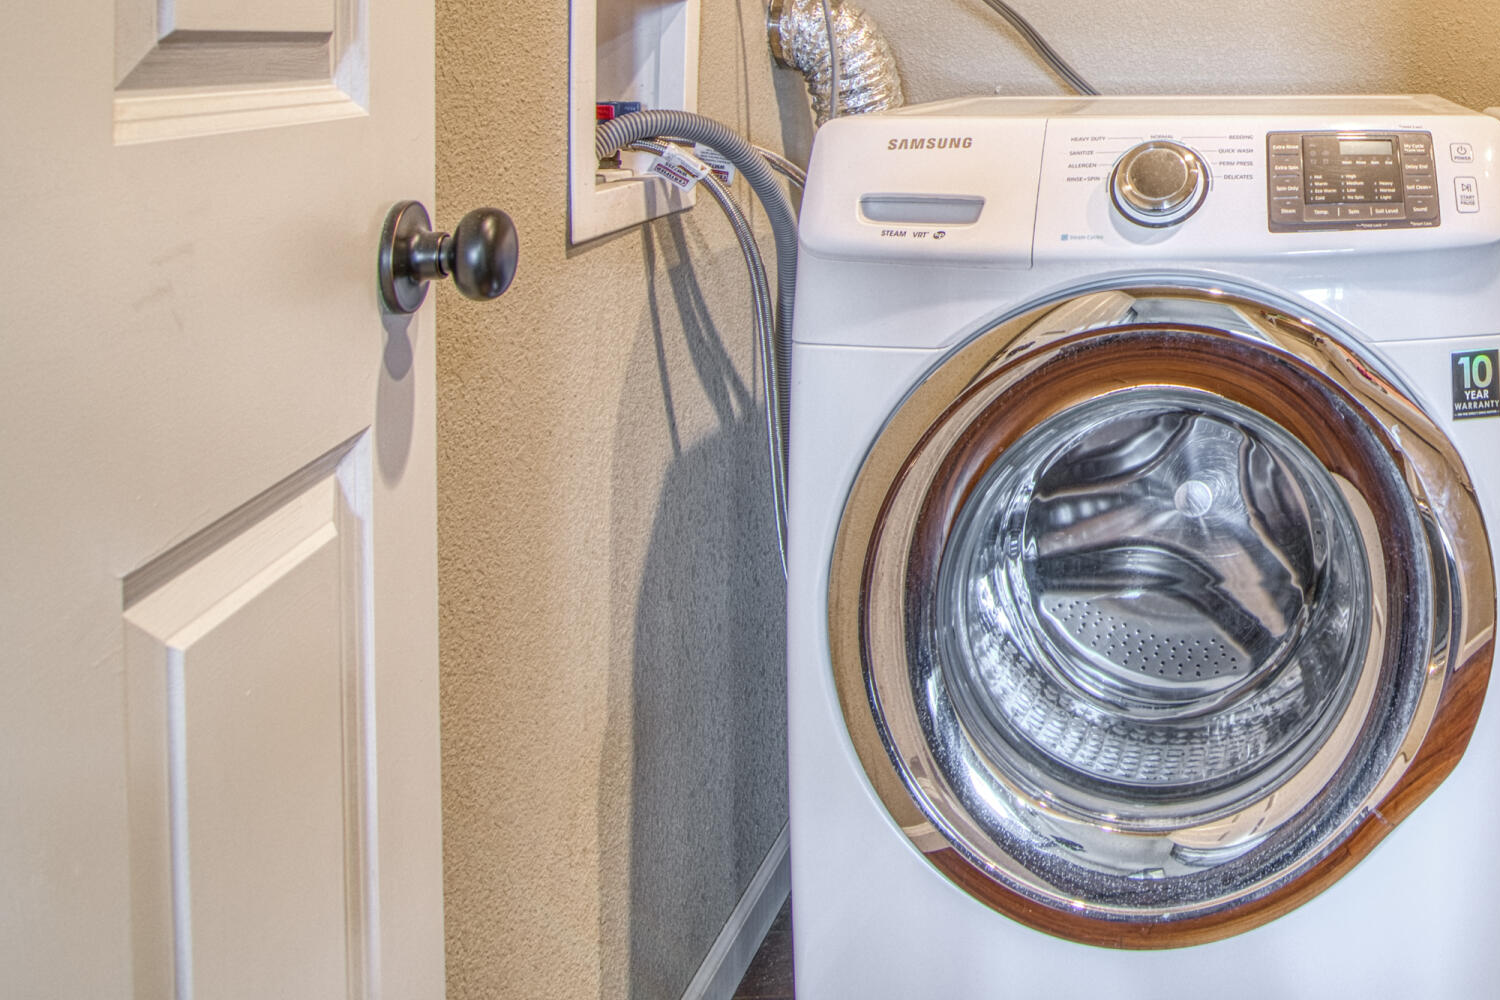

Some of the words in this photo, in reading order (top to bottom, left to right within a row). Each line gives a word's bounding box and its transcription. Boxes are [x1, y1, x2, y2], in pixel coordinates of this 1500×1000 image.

[887, 137, 973, 150] SAMSUNG
[880, 229, 907, 237] STEAM
[1457, 354, 1493, 389] 10
[1464, 389, 1489, 400] YEAR
[1454, 400, 1500, 411] WARRANTY
